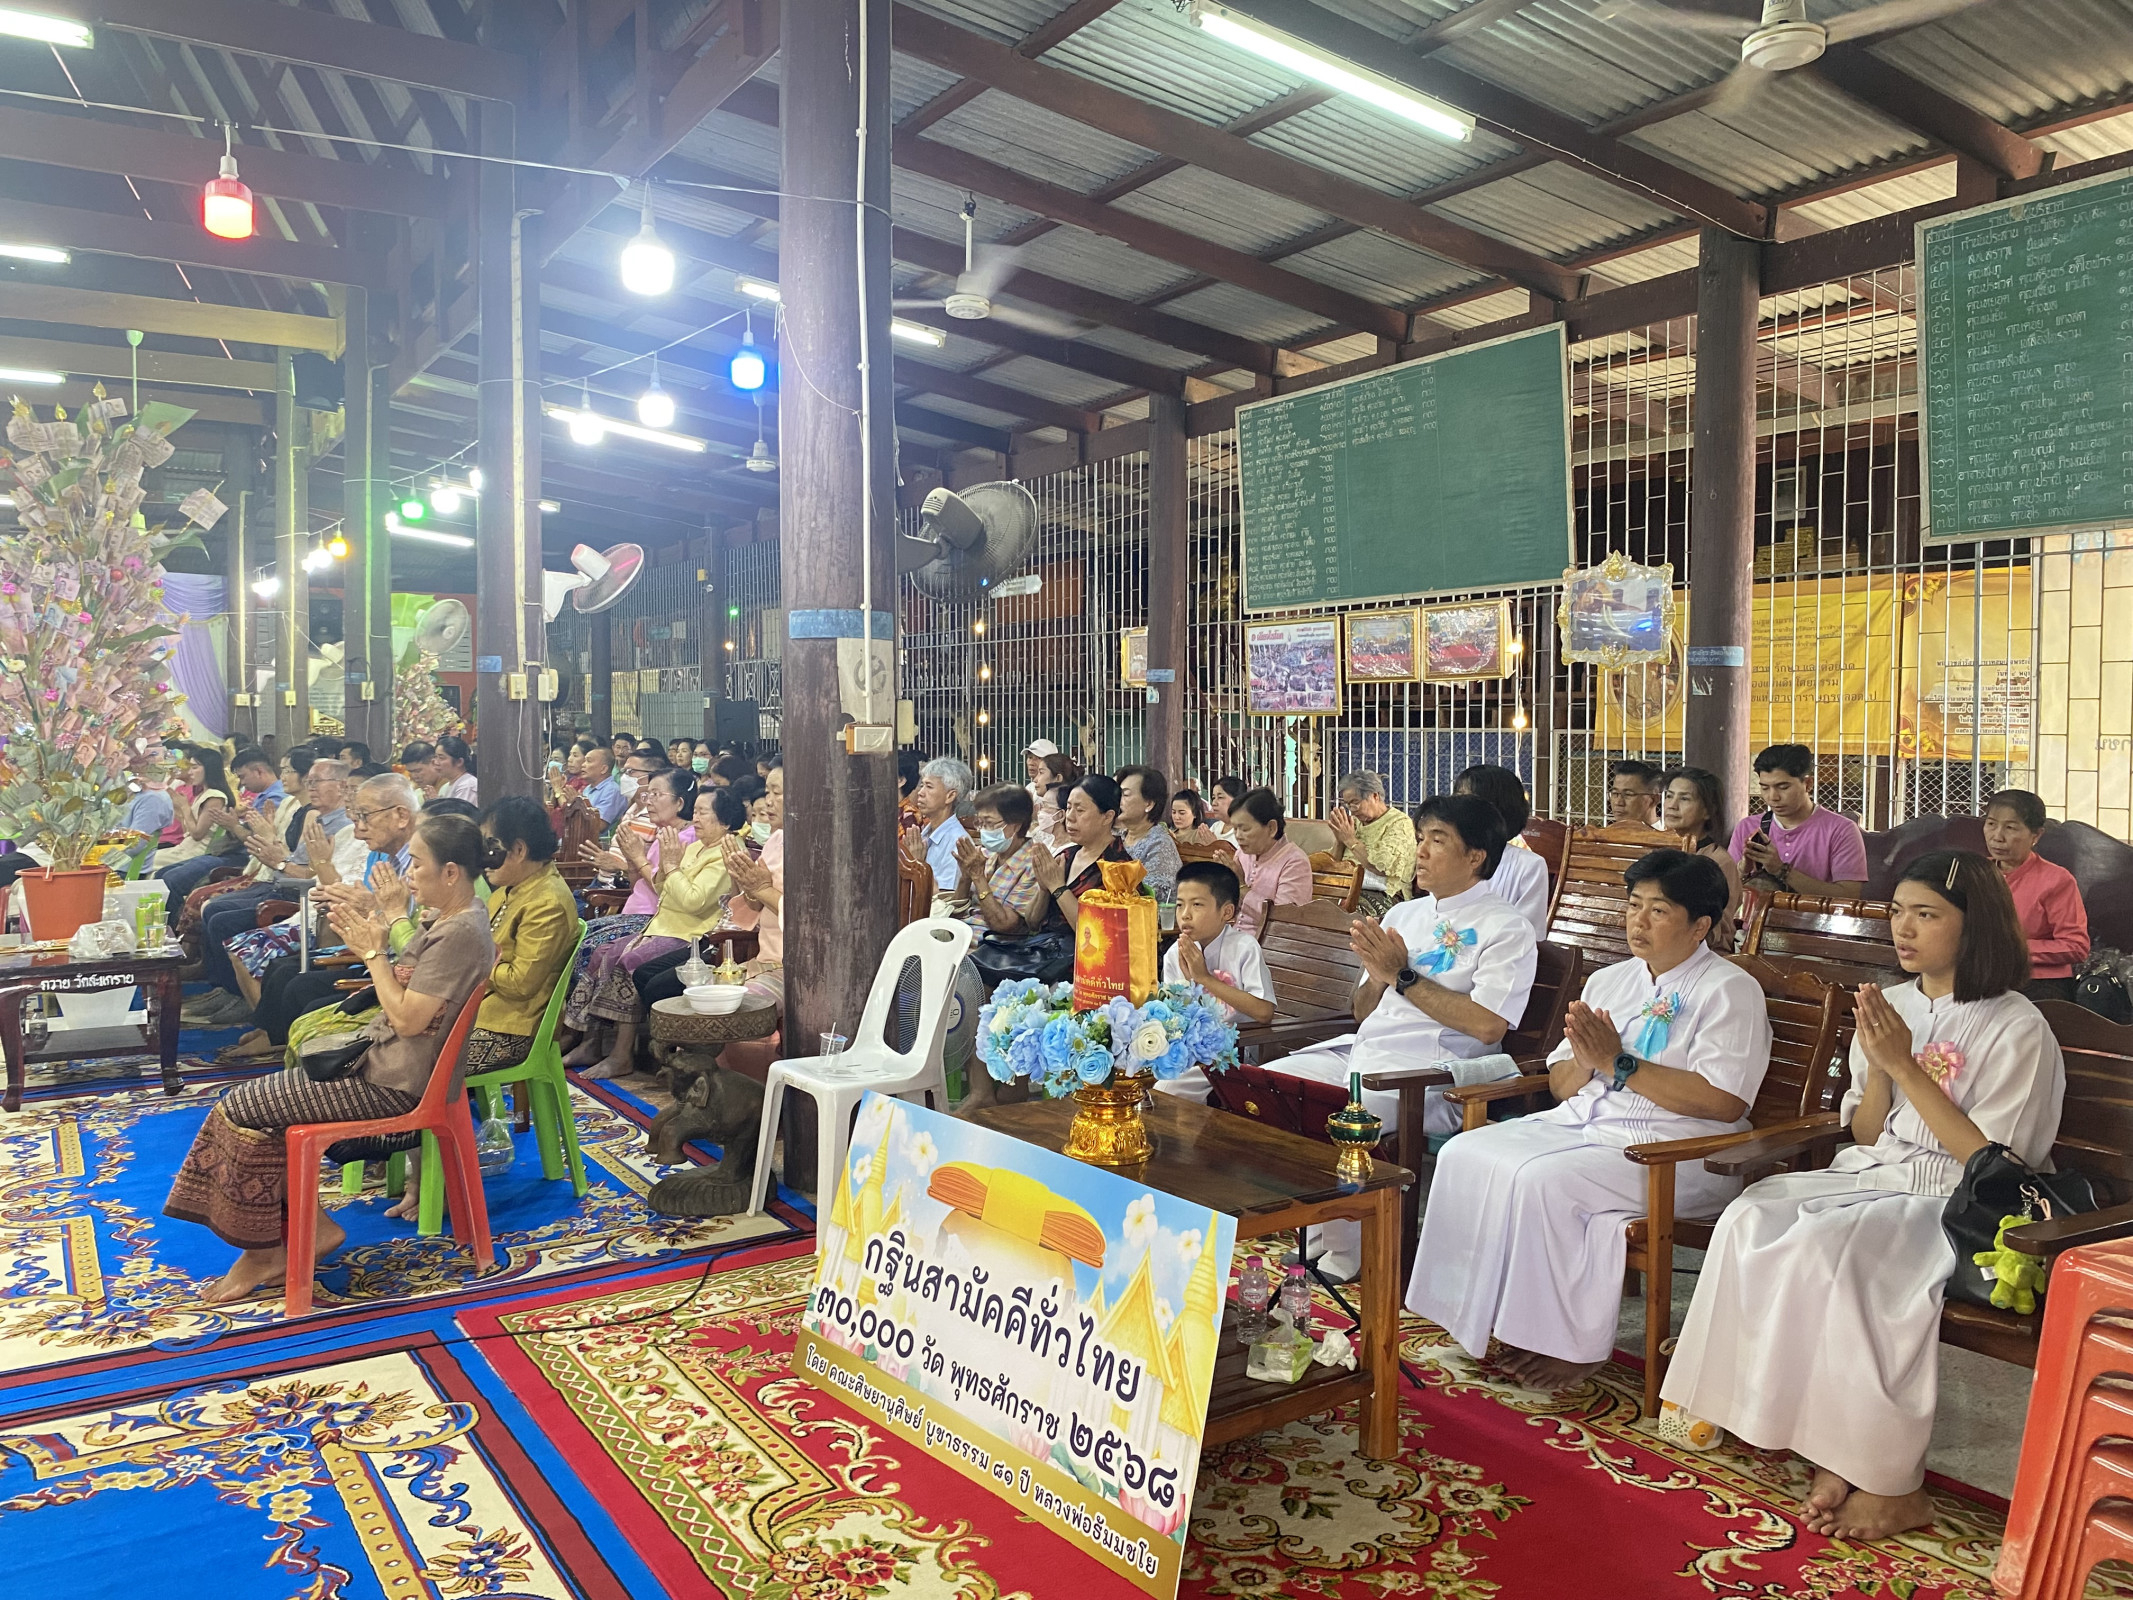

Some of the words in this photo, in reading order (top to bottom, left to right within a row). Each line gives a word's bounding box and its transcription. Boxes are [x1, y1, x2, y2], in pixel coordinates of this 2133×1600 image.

[41, 980, 70, 990] ถวาย
[816, 1287, 915, 1359] ๓๐,๐๐๐
[921, 1335, 945, 1378] วัด
[950, 1360, 1061, 1441] พุทธศักราช
[1070, 1411, 1178, 1507] ๒๕๖๘
[863, 1230, 1141, 1404] กฐินสามัคคีทั่วไทย
[805, 1344, 828, 1373] โดย
[828, 1362, 924, 1431] คณะศิษยานุศิษย์
[925, 1417, 990, 1469] บูชาธรรม
[992, 1463, 1016, 1488] ๘๑
[1017, 1468, 1031, 1496] ปี
[1034, 1485, 1159, 1576] หลวงพ่อธัมมชโย
